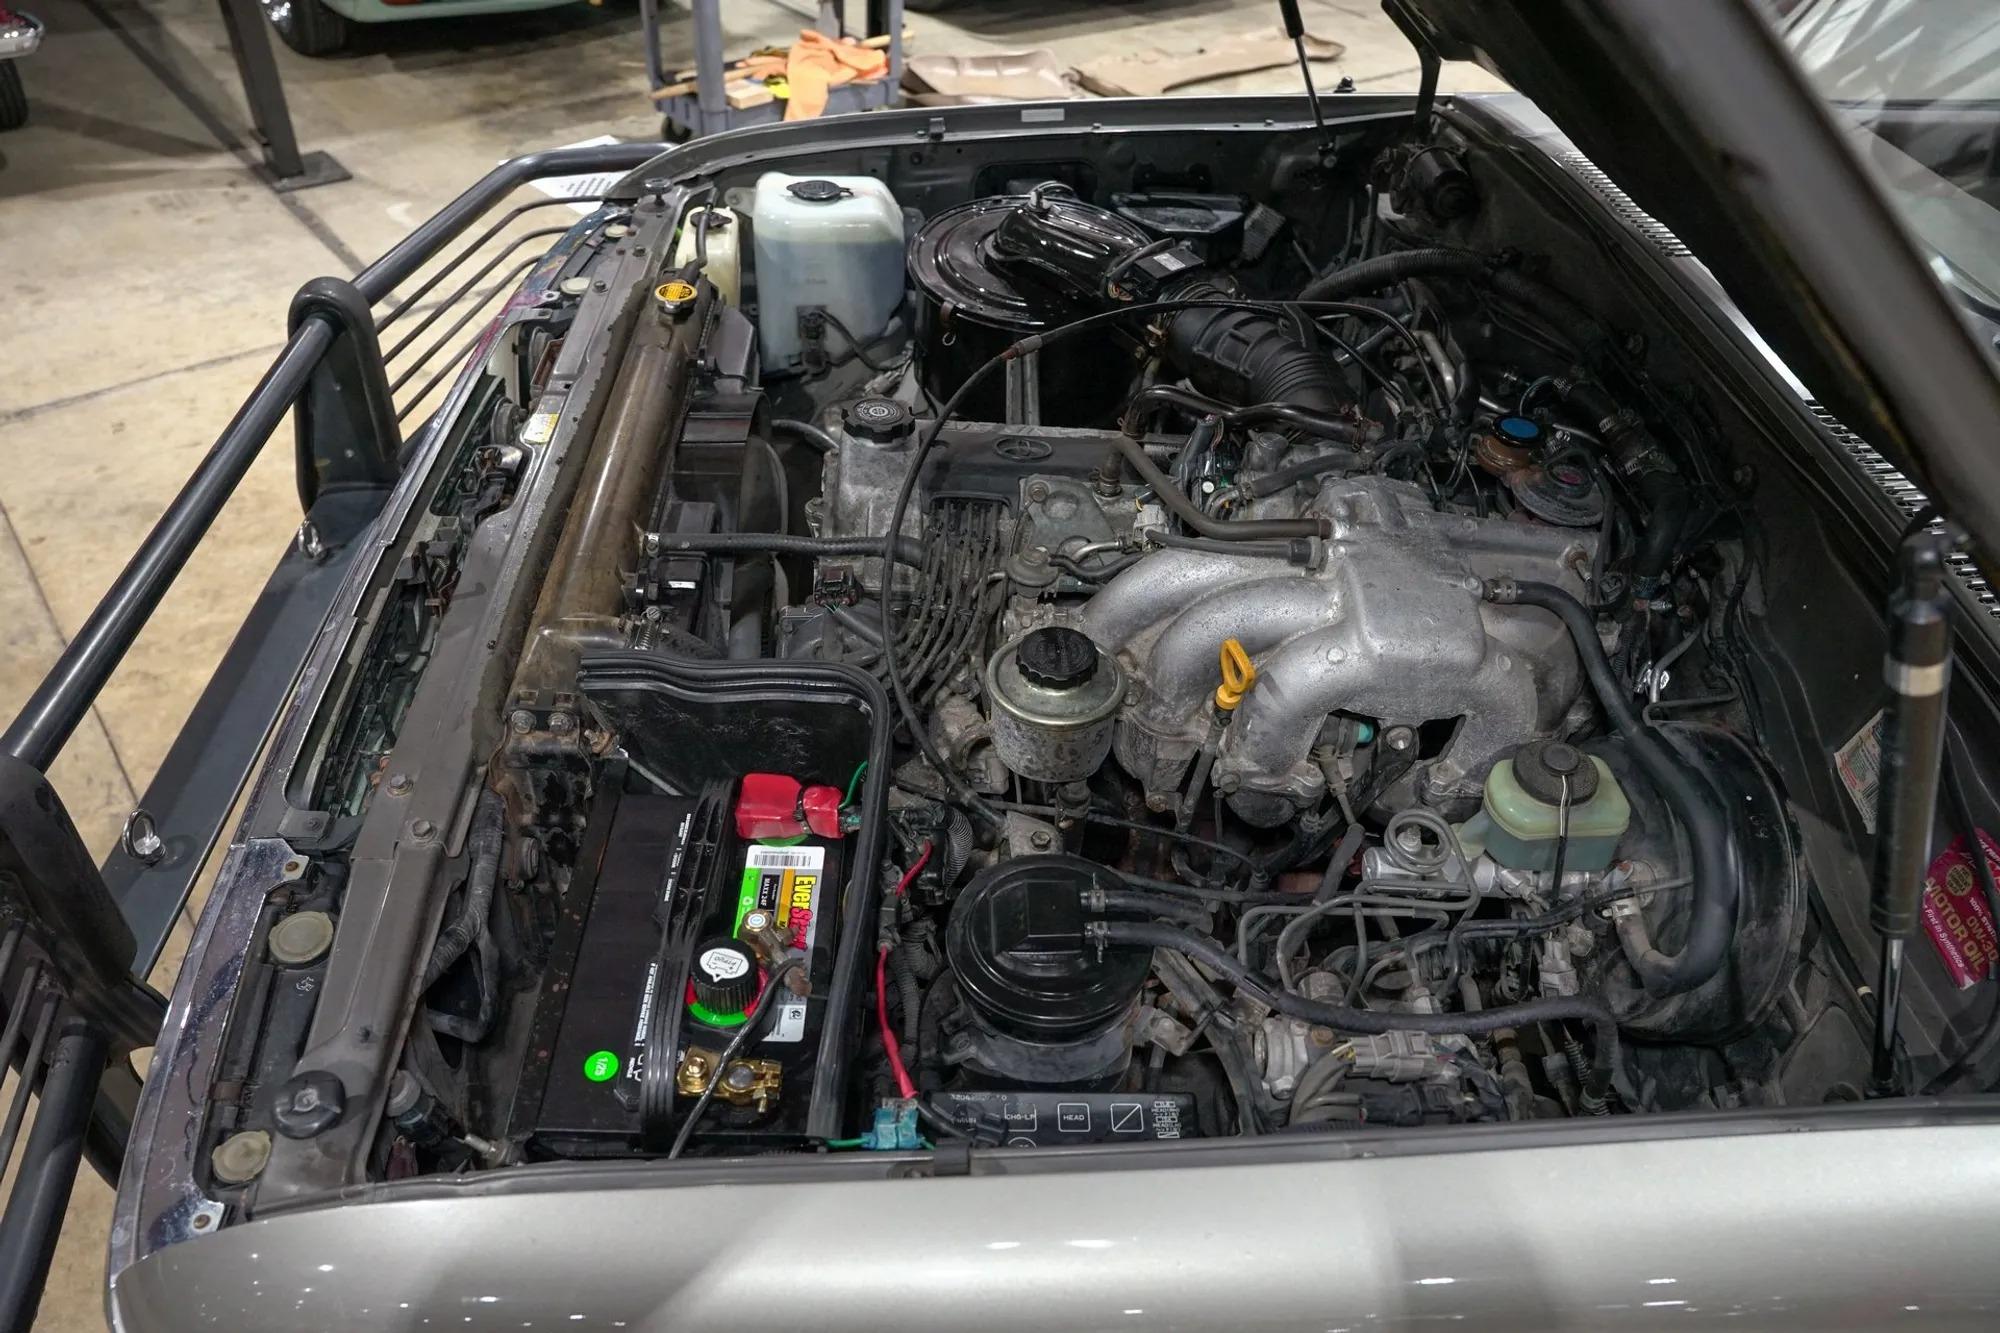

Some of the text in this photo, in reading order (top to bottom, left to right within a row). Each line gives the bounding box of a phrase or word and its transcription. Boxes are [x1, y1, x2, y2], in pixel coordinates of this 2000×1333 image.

[762, 878, 770, 894] MAXX
[1925, 876, 1969, 942] MOTOR
[1965, 941, 1986, 972] OIL
[1926, 909, 1939, 925] First
[1939, 932, 1965, 968] Synthetics
[1966, 916, 1999, 962] 0W-30
